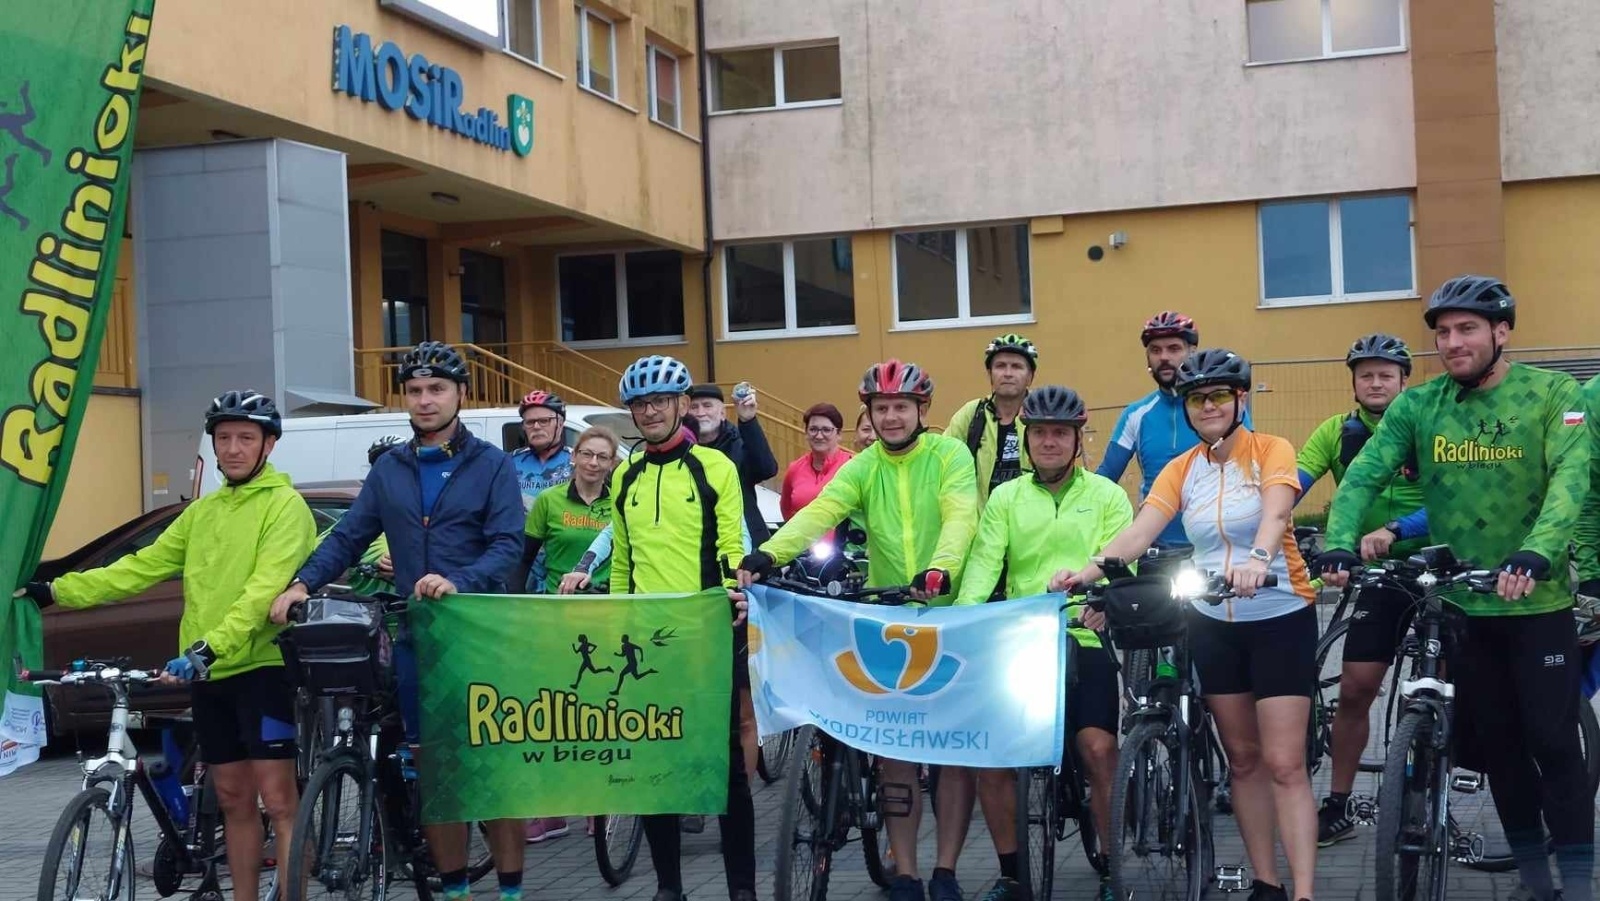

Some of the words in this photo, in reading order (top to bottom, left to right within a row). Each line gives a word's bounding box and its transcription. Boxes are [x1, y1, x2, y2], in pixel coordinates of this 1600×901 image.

[0, 10, 152, 487] Radlinioki
[1433, 434, 1523, 463] Radlinioki
[468, 682, 684, 748] Radlinioki
[865, 709, 928, 724] POWIAT
[522, 751, 545, 763] w
[553, 745, 632, 765] biegu
